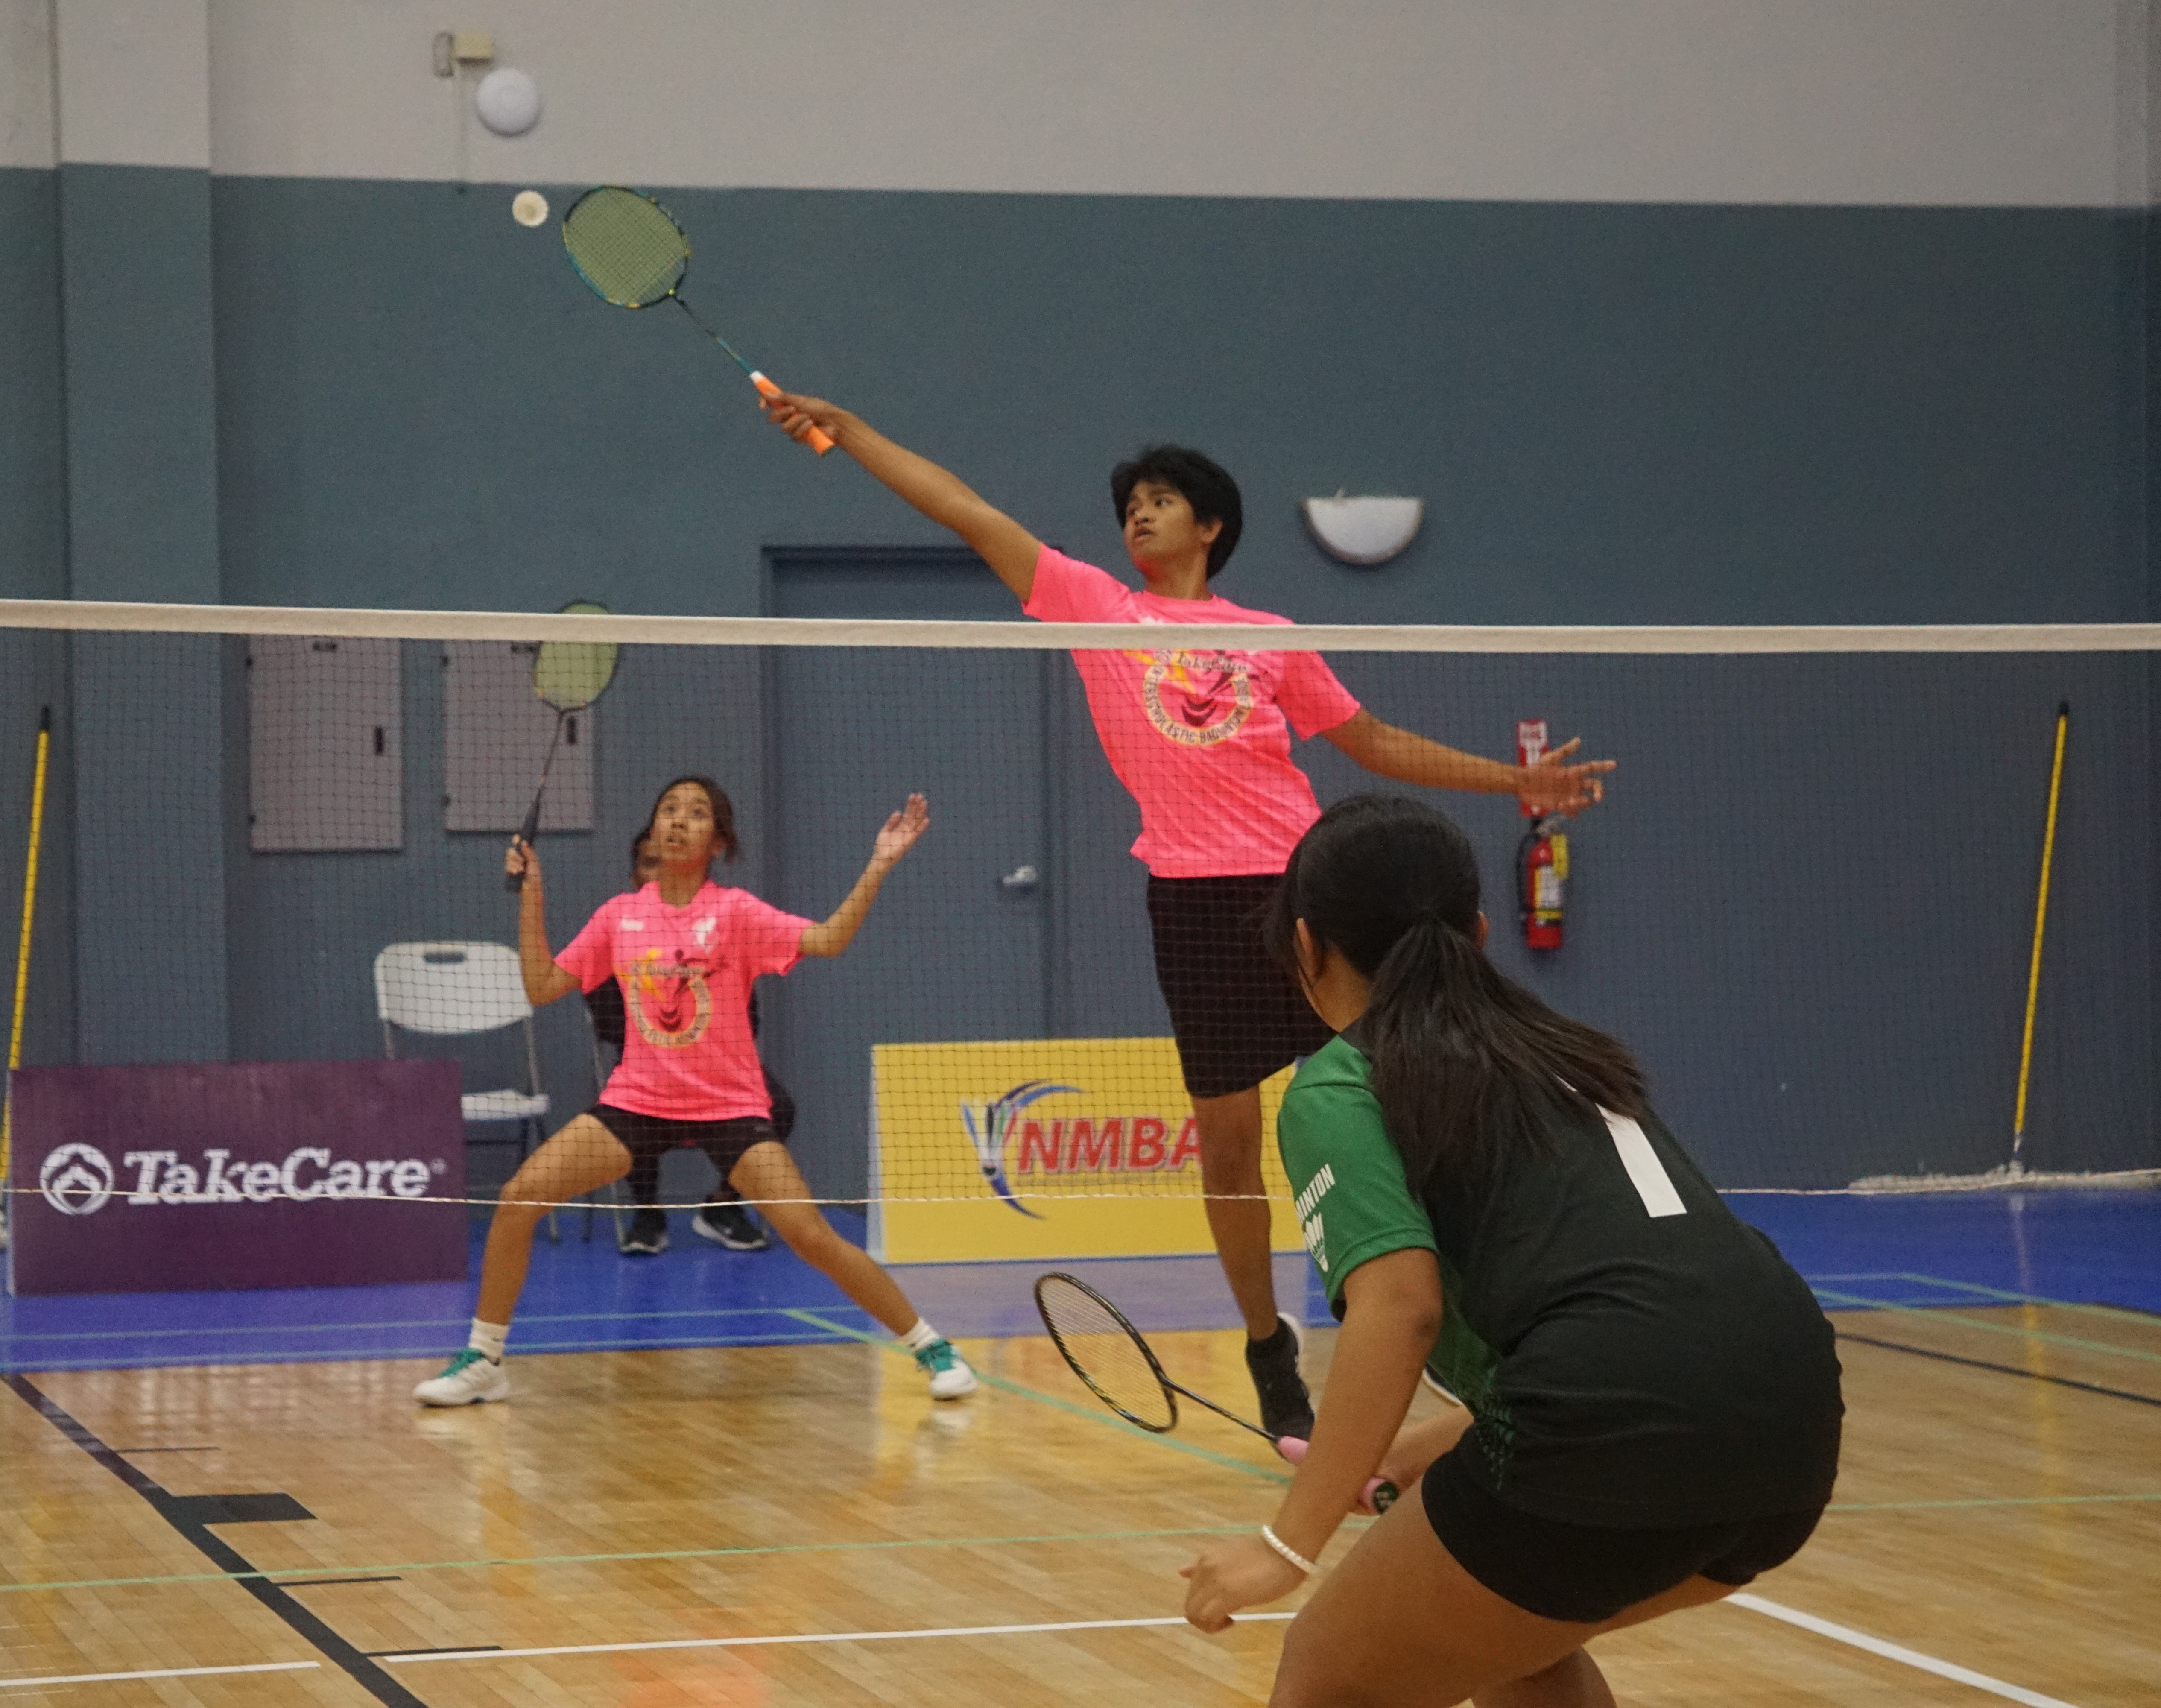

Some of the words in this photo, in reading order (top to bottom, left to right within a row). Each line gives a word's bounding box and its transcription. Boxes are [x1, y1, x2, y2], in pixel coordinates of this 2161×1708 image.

[1018, 1115, 1202, 1173] NMBA
[1594, 1102, 1687, 1218] 1
[124, 1147, 430, 1204] TakeCare
